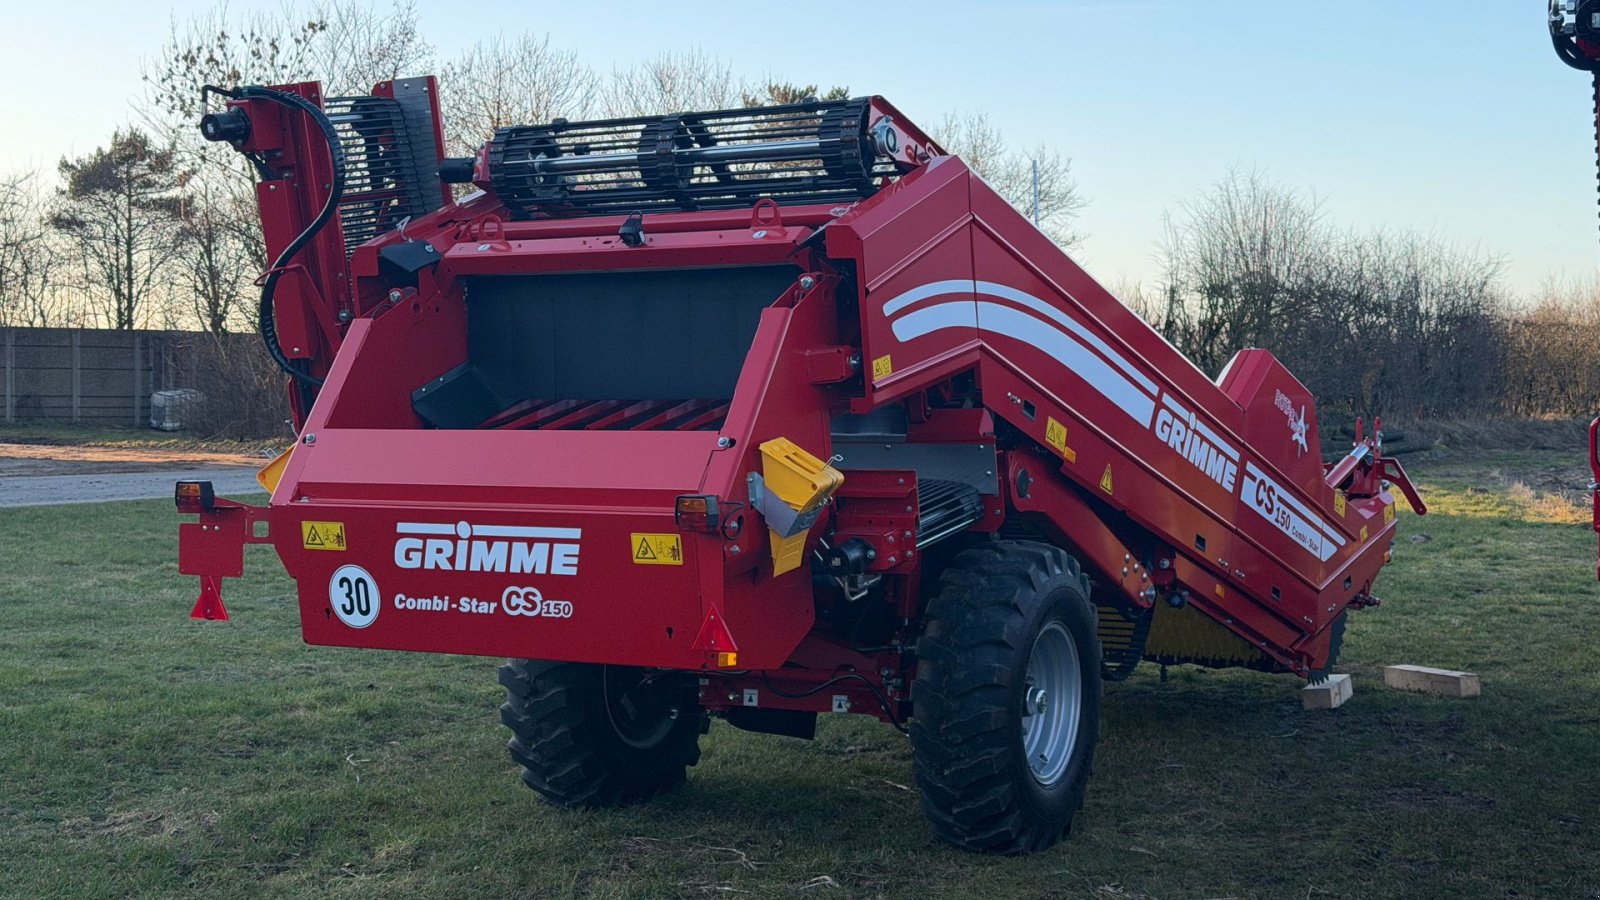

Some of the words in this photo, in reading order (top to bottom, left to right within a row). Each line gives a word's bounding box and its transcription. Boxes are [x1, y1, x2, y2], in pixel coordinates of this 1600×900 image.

[1155, 409, 1238, 494] GRIMME
[394, 521, 582, 575] GRIMME
[338, 576, 371, 616] 30
